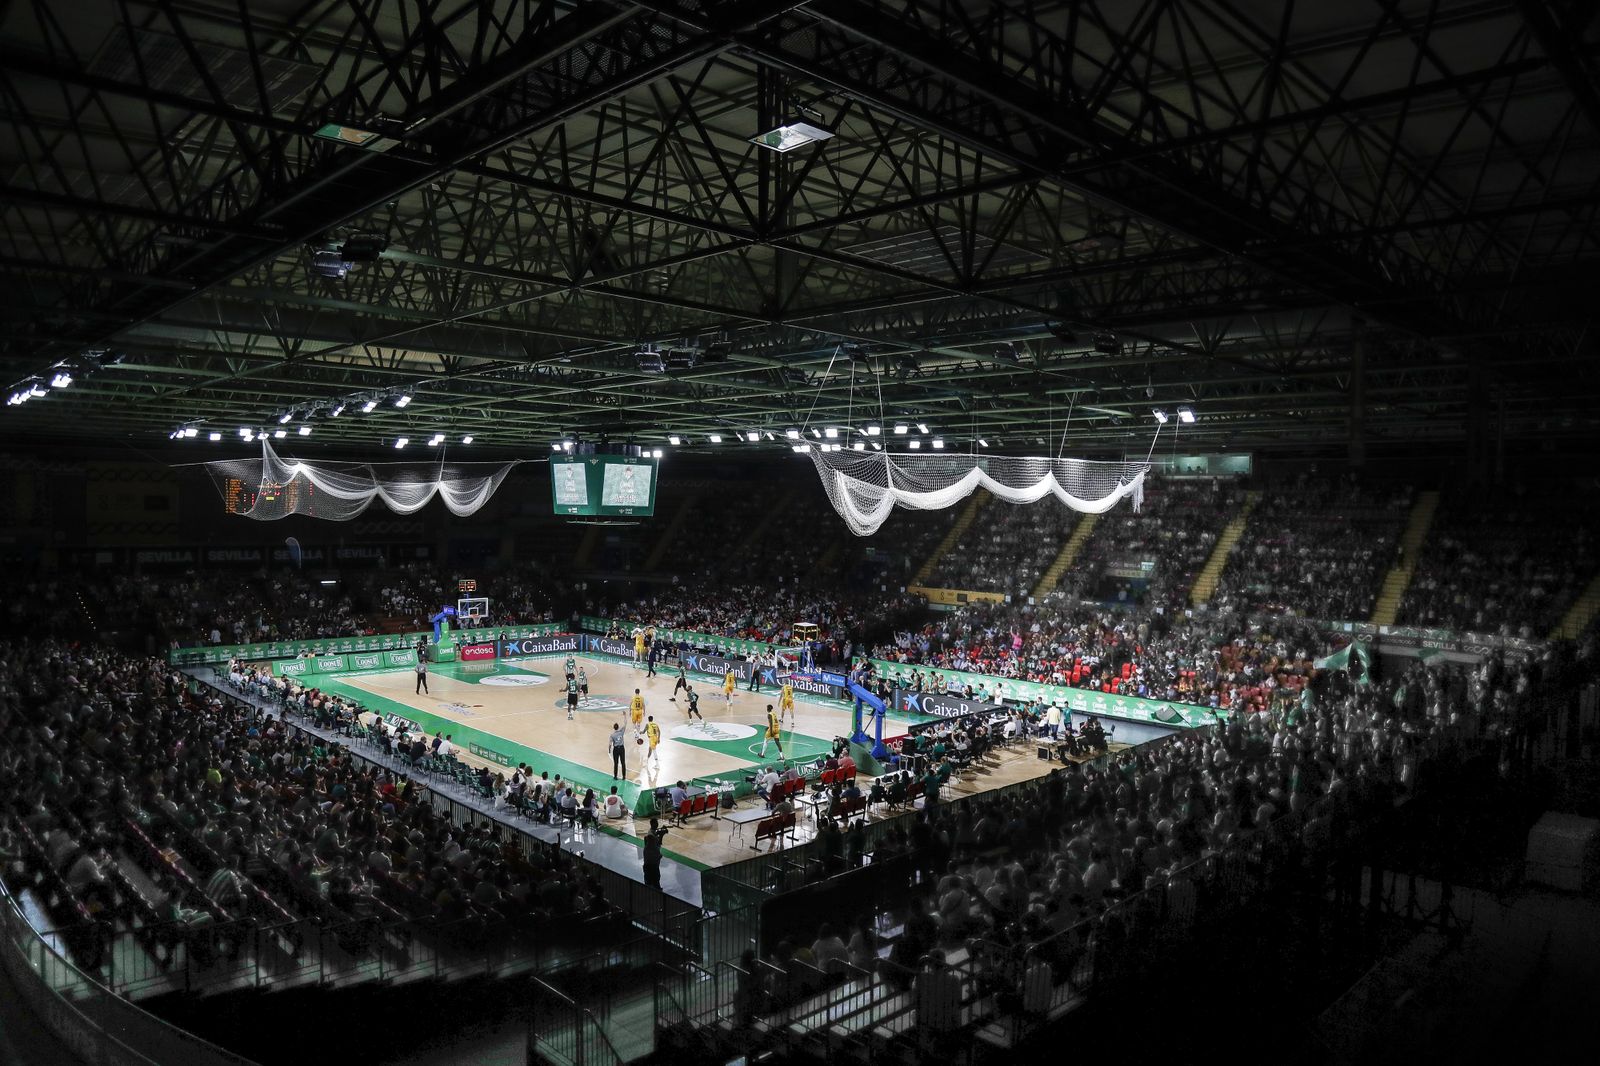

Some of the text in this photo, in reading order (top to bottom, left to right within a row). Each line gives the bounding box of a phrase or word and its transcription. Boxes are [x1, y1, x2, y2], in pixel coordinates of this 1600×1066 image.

[465, 647, 494, 655] endesa
[522, 640, 577, 653] CaixaBank
[600, 640, 635, 657] CaixaBan
[922, 697, 969, 717] CaixaB
